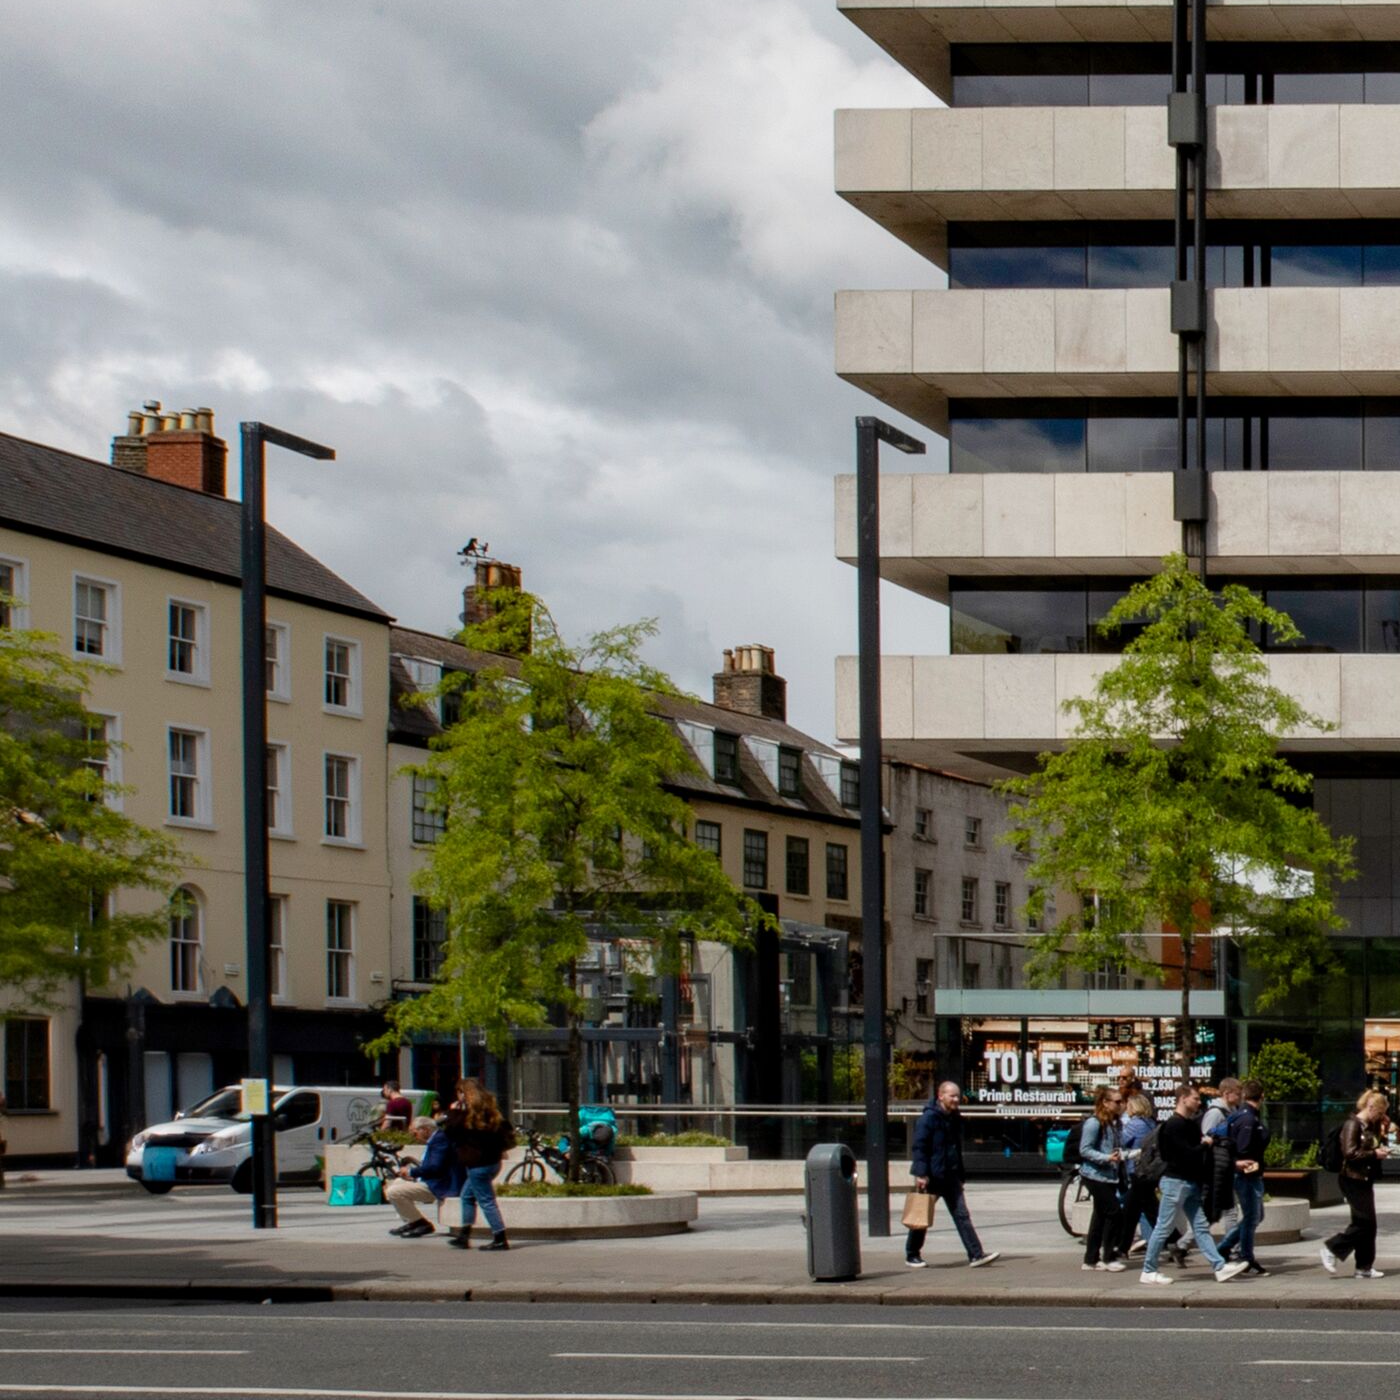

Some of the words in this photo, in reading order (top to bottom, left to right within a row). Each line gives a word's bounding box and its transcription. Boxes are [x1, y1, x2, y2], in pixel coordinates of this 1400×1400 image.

[983, 1051, 1019, 1083] TO
[1025, 1051, 1074, 1083] LET
[1106, 1066, 1139, 1077] GROD
[1140, 1066, 1163, 1077] FLOOR
[1174, 1066, 1212, 1077] BAMENT
[979, 1089, 1012, 1102] Prime
[1014, 1089, 1077, 1102] Restaurant
[1153, 1097, 1176, 1107] RACE
